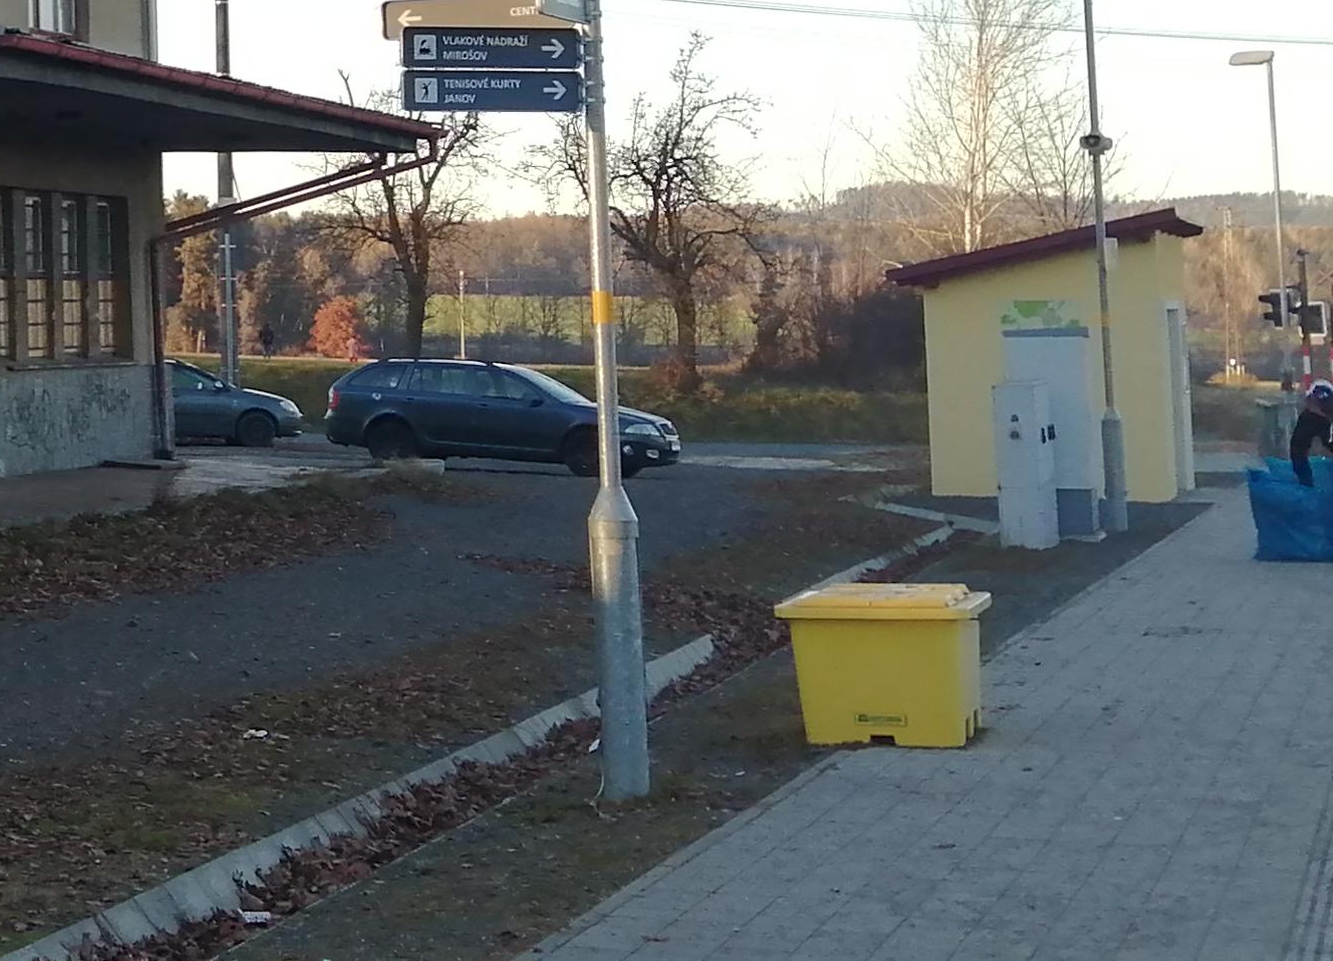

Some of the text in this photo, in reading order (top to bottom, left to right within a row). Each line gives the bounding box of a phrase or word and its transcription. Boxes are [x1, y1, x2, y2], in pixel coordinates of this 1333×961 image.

[509, 5, 539, 16] CENT
[443, 34, 529, 47] VLAKOVÉ NÁDRAŽÍ
[443, 49, 488, 60] MIROŠOV
[444, 77, 521, 89] TENISOVÉ KURTY
[444, 93, 476, 104] JANOV
